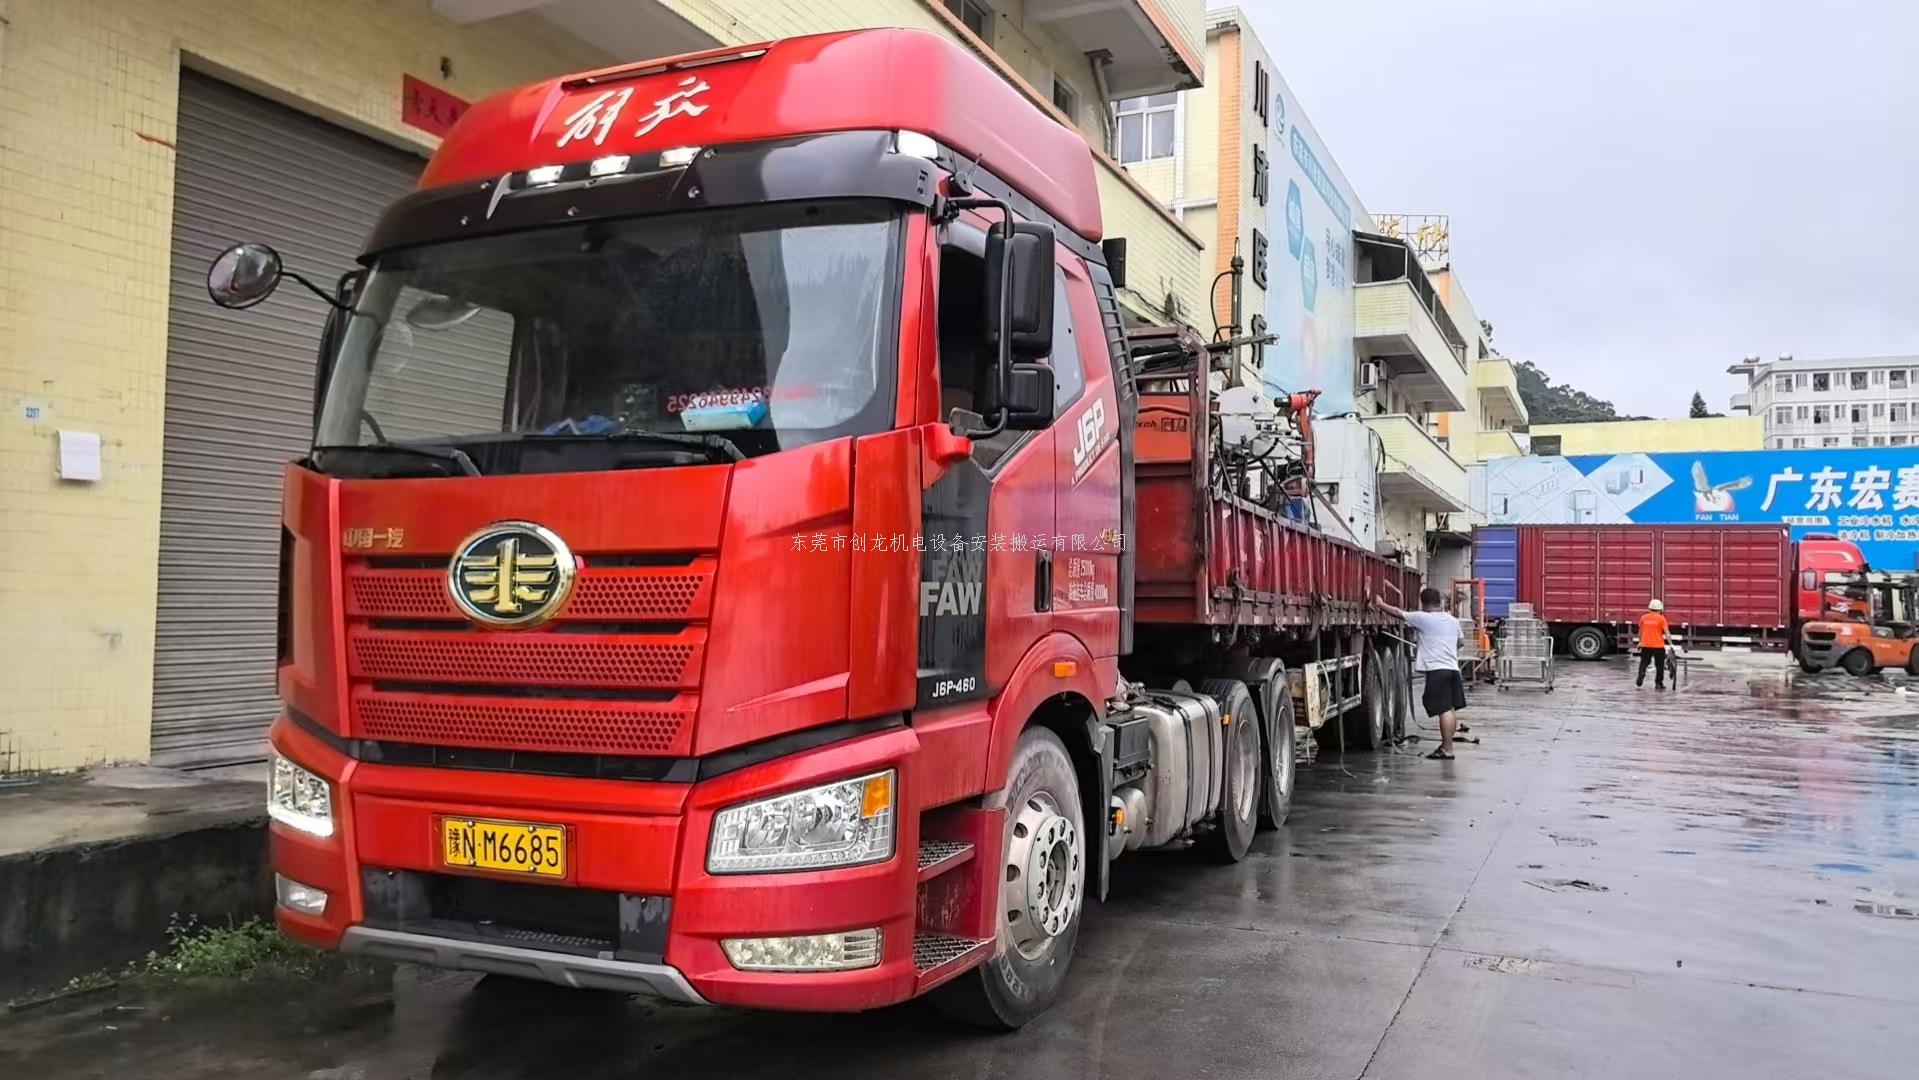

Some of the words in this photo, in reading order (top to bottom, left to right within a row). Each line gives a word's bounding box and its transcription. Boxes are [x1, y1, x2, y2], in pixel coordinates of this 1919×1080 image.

[1073, 397, 1105, 467] J6P
[1695, 513, 1713, 521] FAN
[1719, 512, 1739, 521] TIAN
[920, 582, 982, 616] FAW
[933, 677, 976, 698] J6P-460
